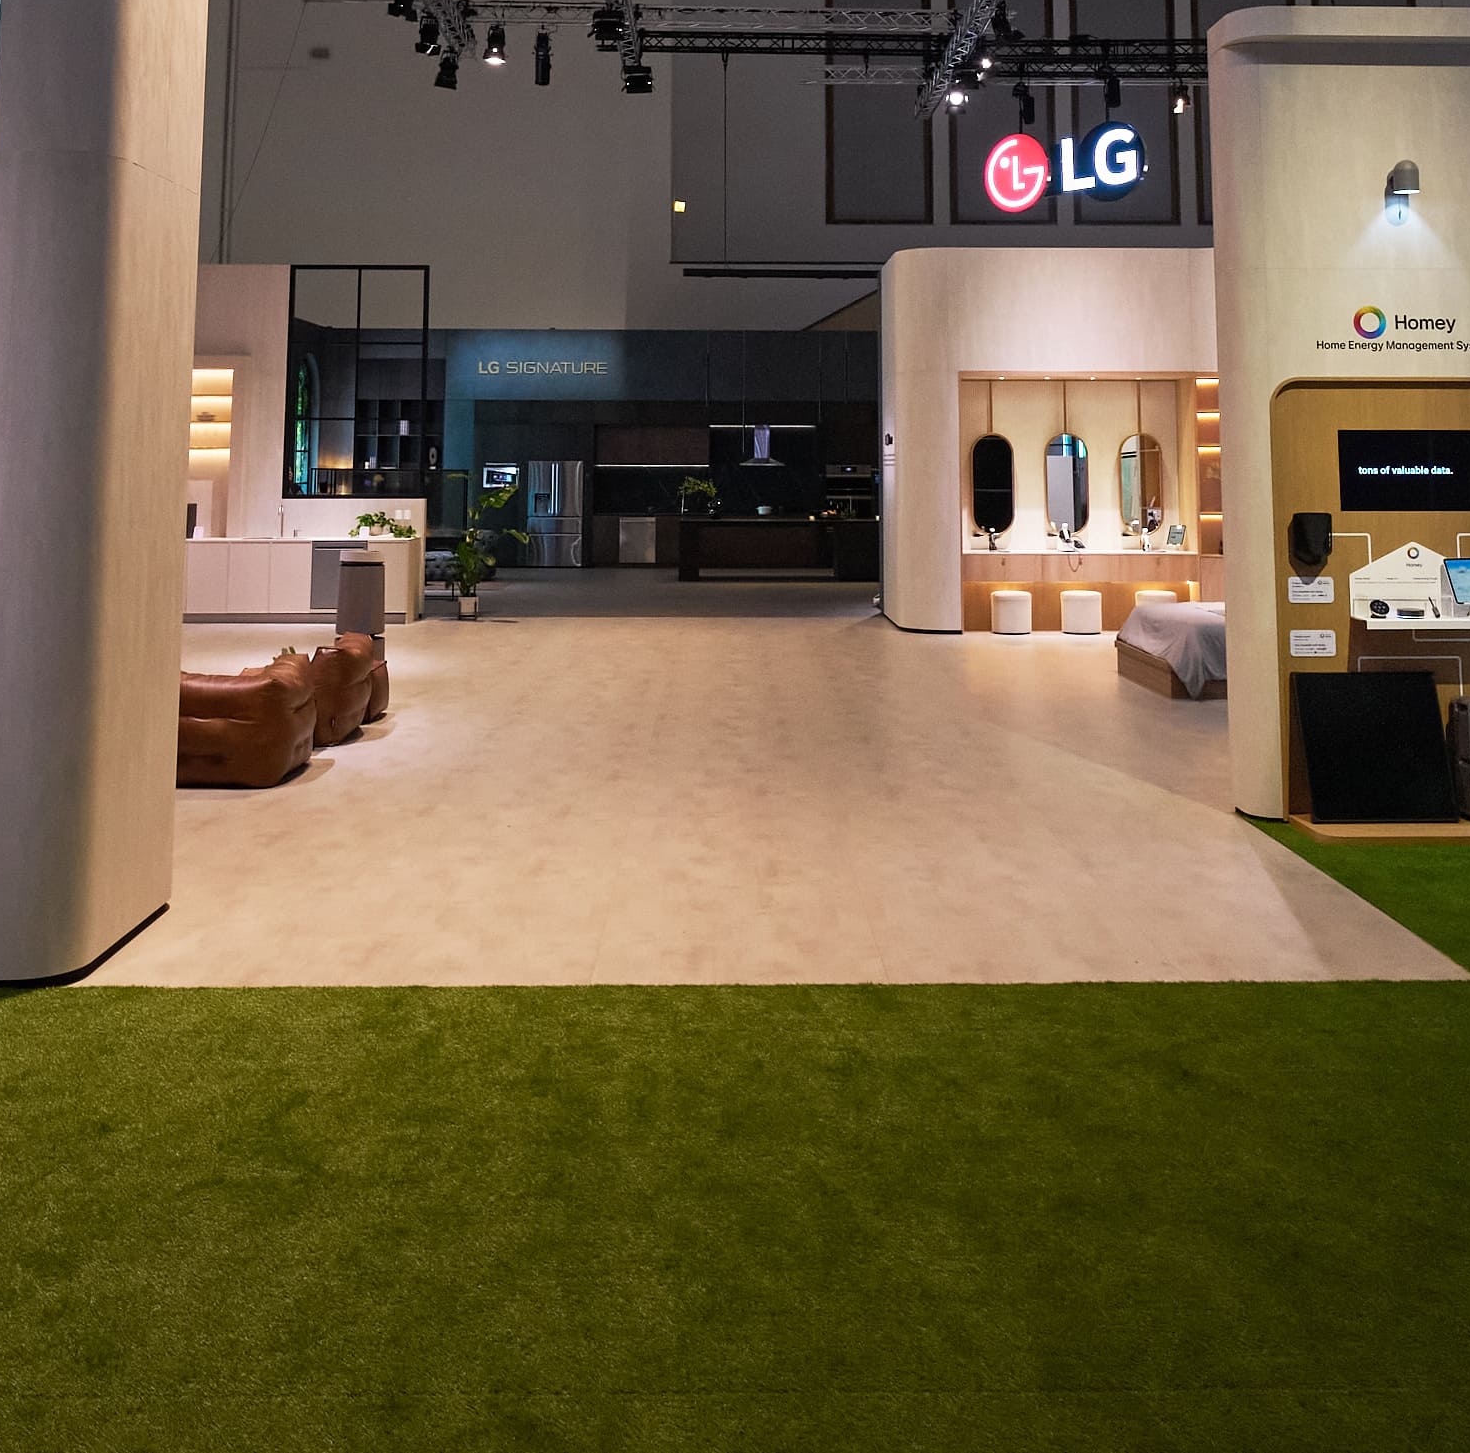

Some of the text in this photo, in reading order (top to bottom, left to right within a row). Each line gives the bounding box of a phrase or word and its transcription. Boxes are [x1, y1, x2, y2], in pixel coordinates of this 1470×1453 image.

[1060, 128, 1138, 192] LG
[1394, 315, 1456, 333] Homey
[1316, 340, 1346, 350] Home
[1349, 341, 1383, 351] Energy
[1386, 341, 1454, 352] Management
[478, 361, 608, 374] LG SIGNATURE
[1358, 465, 1454, 475] tons of valuable data.
